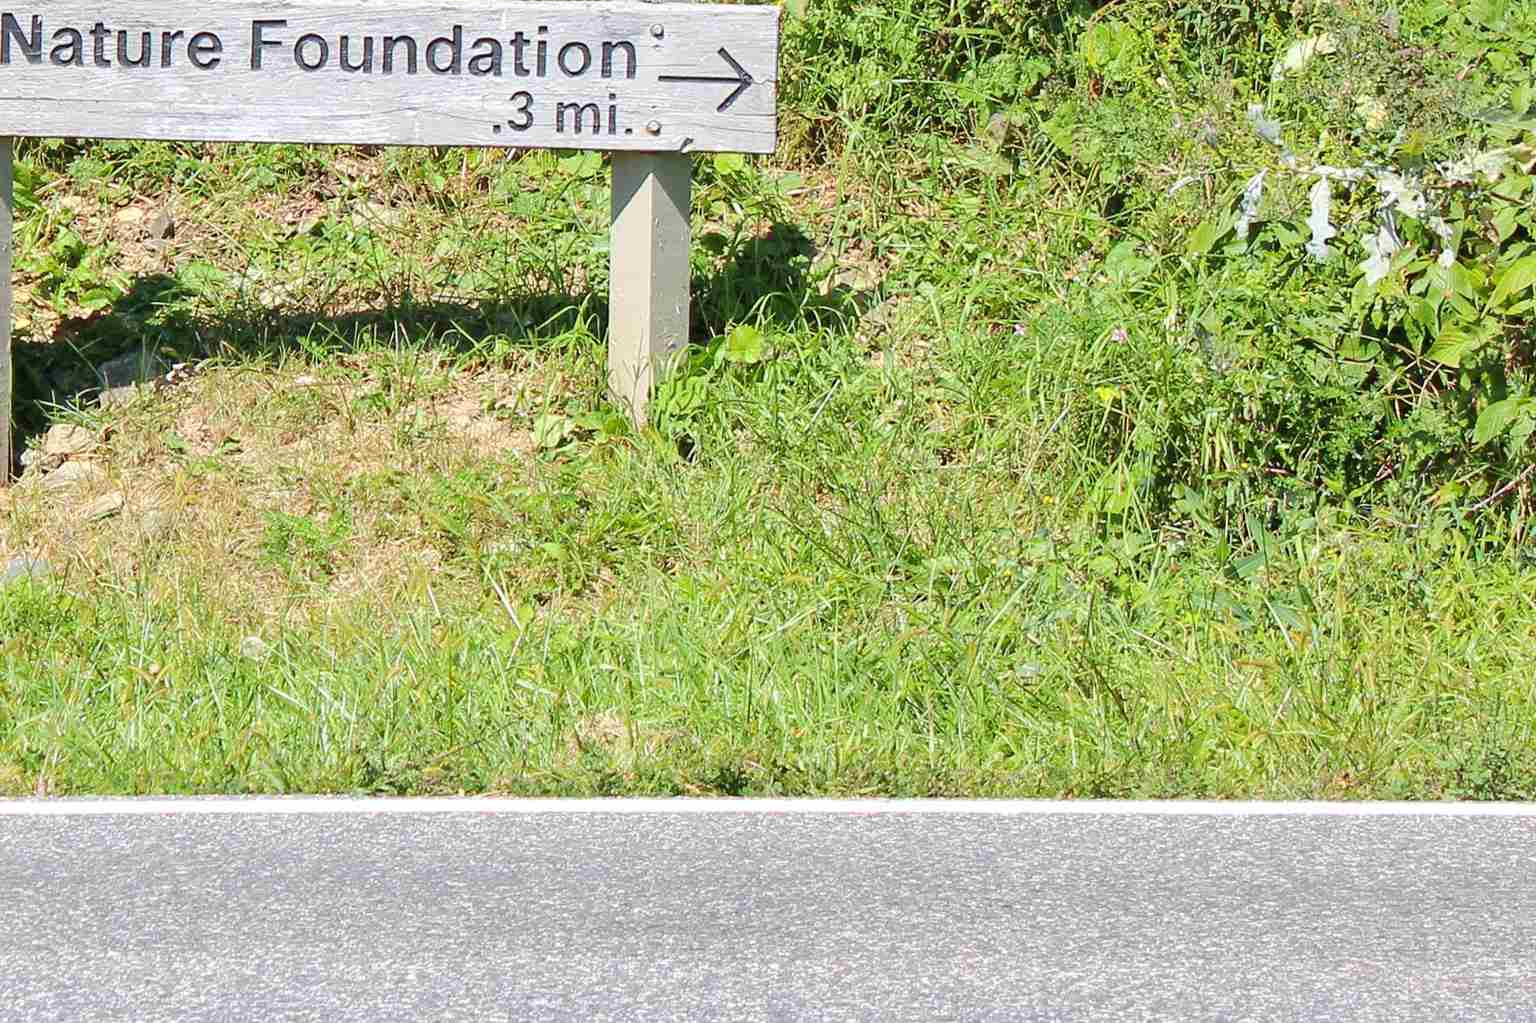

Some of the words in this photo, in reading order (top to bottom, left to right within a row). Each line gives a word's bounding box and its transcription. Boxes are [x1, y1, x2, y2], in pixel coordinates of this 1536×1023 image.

[0, 12, 223, 70] Nature
[249, 18, 637, 79] Foundation
[492, 90, 535, 133] .3
[555, 93, 633, 135] mi.
